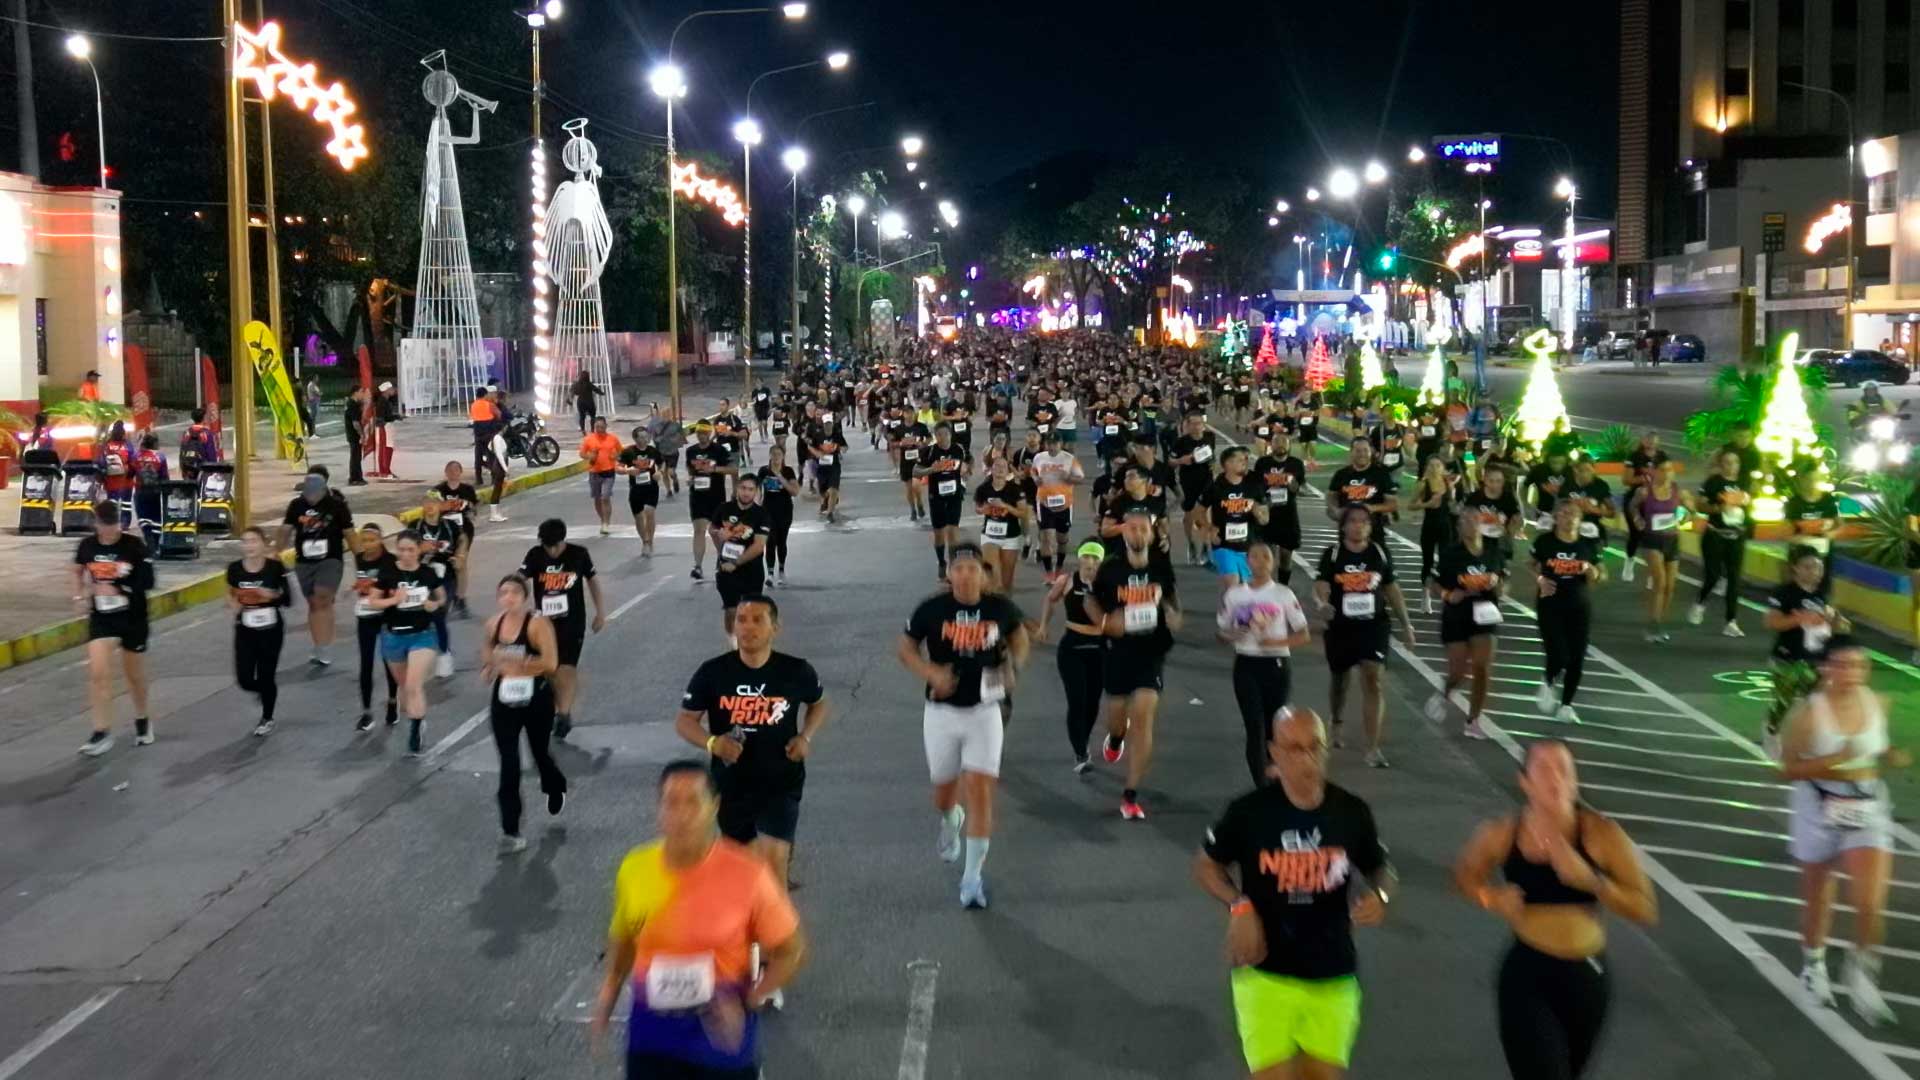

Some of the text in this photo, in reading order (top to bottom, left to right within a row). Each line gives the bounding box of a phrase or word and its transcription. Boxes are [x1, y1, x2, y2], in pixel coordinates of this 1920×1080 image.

[736, 683, 767, 701] CLX
[720, 696, 785, 711] NIGHT
[730, 710, 779, 725] RUN
